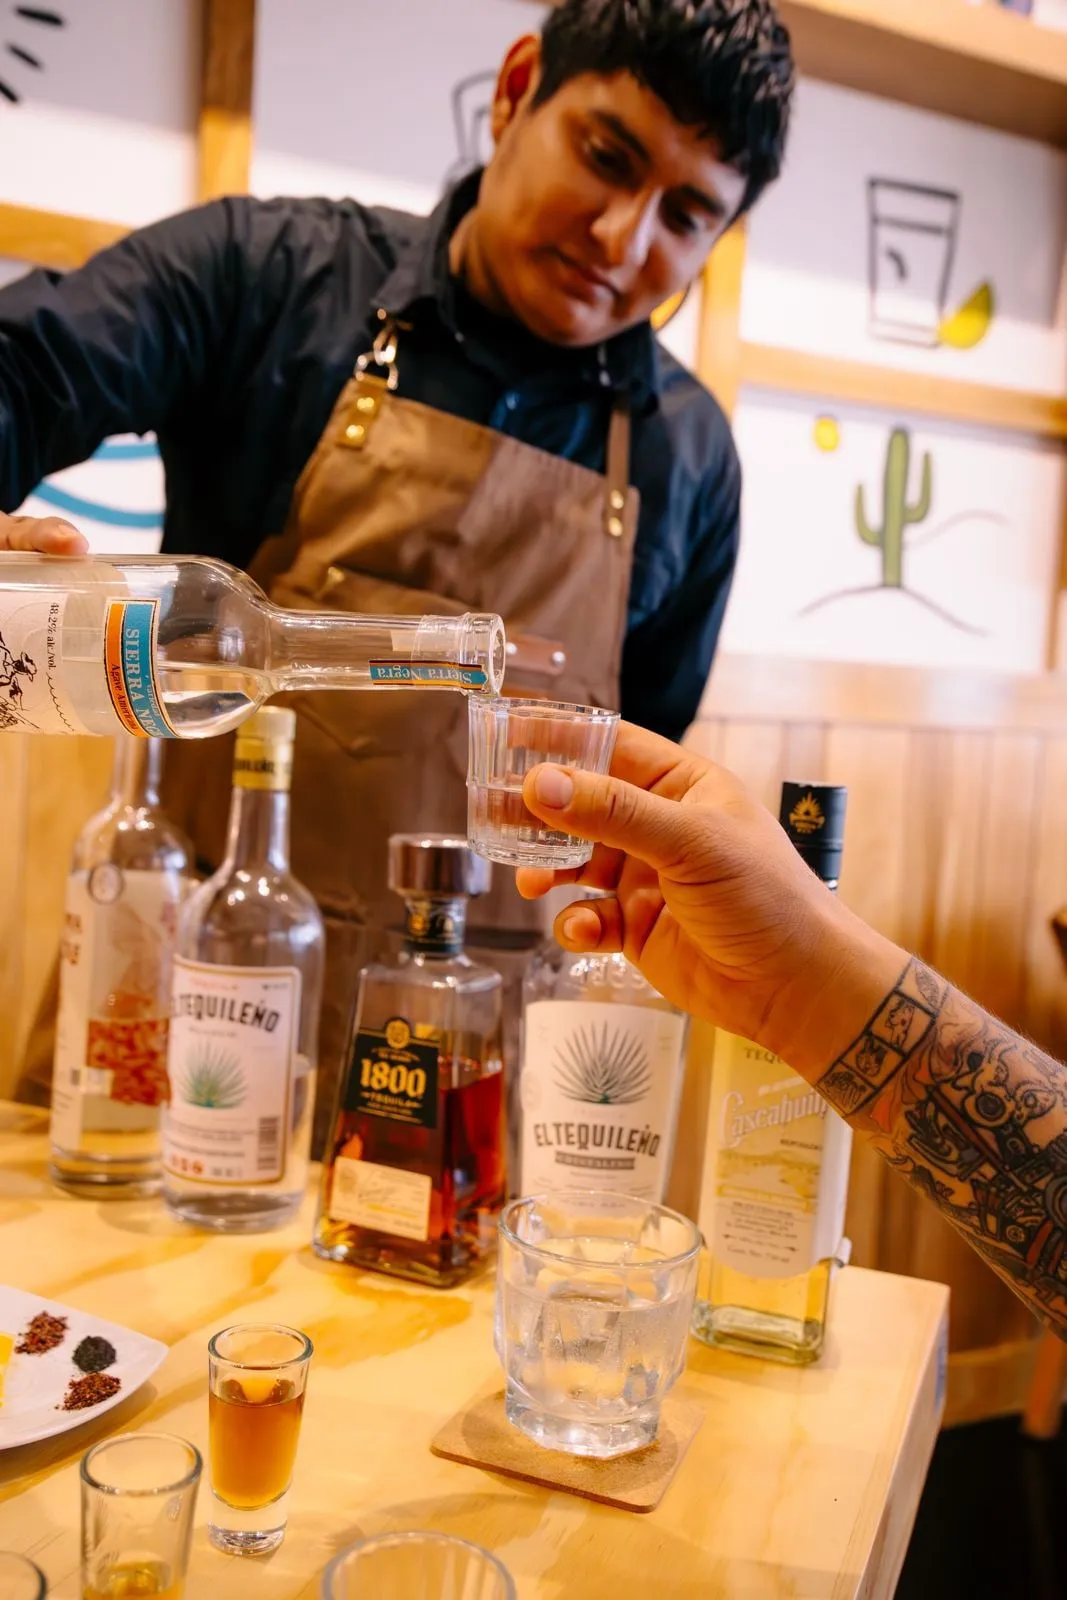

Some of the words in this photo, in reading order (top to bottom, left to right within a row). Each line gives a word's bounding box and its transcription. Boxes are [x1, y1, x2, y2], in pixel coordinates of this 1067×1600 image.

[48, 603, 59, 633] 48.2%
[110, 664, 122, 691] Agave
[125, 628, 145, 701] SIERRA
[377, 665, 422, 681] Negra
[427, 668, 472, 684] Sierra
[360, 1058, 426, 1098] 1800
